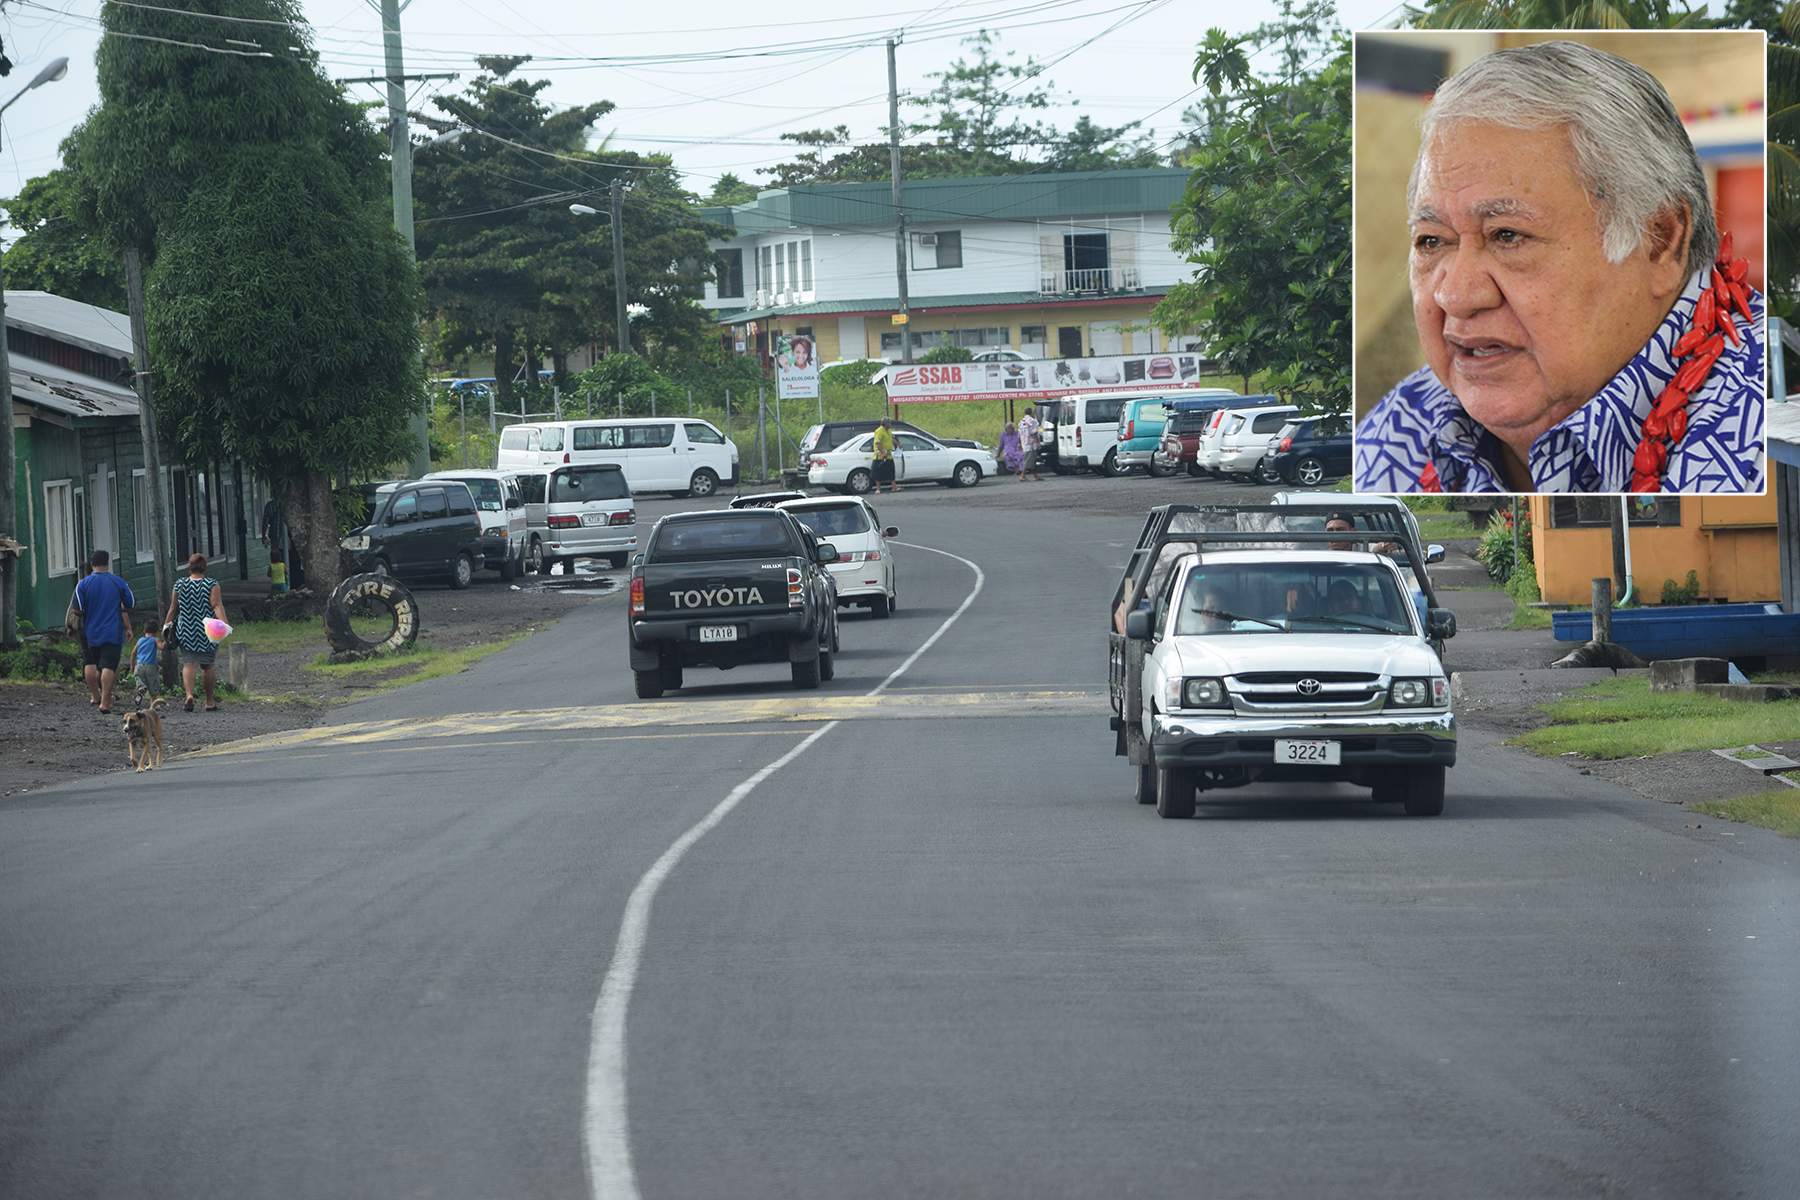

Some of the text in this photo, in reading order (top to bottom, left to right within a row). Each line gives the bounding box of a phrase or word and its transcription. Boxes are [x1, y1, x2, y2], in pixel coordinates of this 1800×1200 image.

[919, 366, 962, 385] SSAB
[342, 581, 396, 605] TYRE
[669, 587, 764, 608] TOYOTA
[703, 628, 733, 639] LTA10
[1288, 744, 1327, 760] 3224
